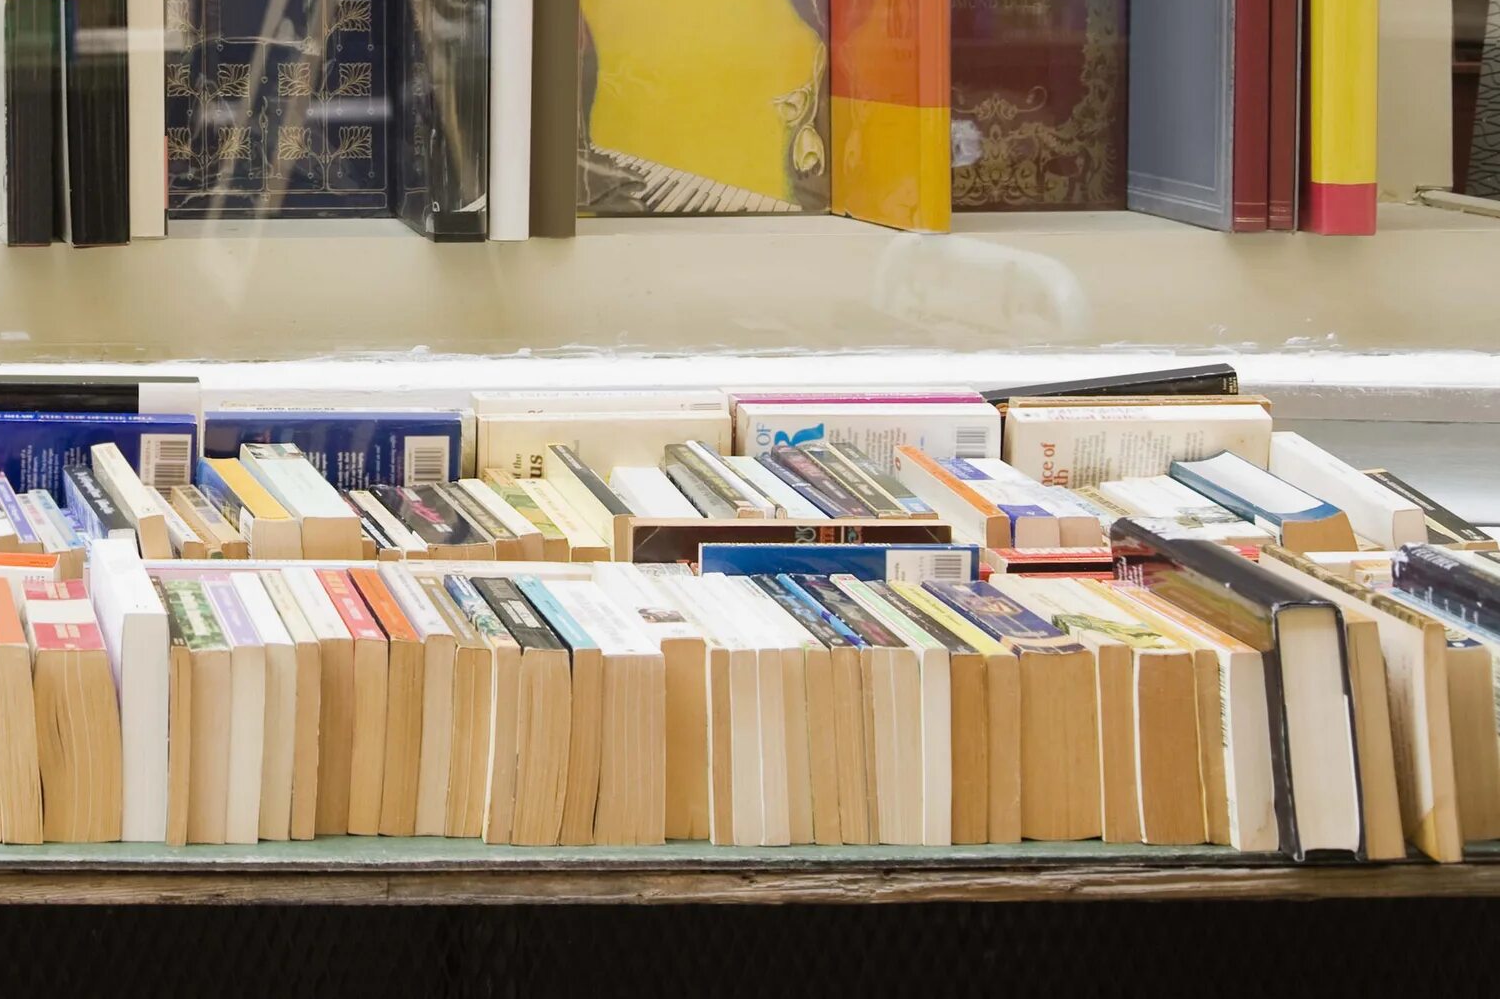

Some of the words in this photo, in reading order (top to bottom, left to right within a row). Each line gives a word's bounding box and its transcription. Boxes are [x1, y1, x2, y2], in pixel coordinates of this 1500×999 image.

[755, 424, 772, 446] OF
[1041, 443, 1055, 458] of
[512, 453, 522, 470] the
